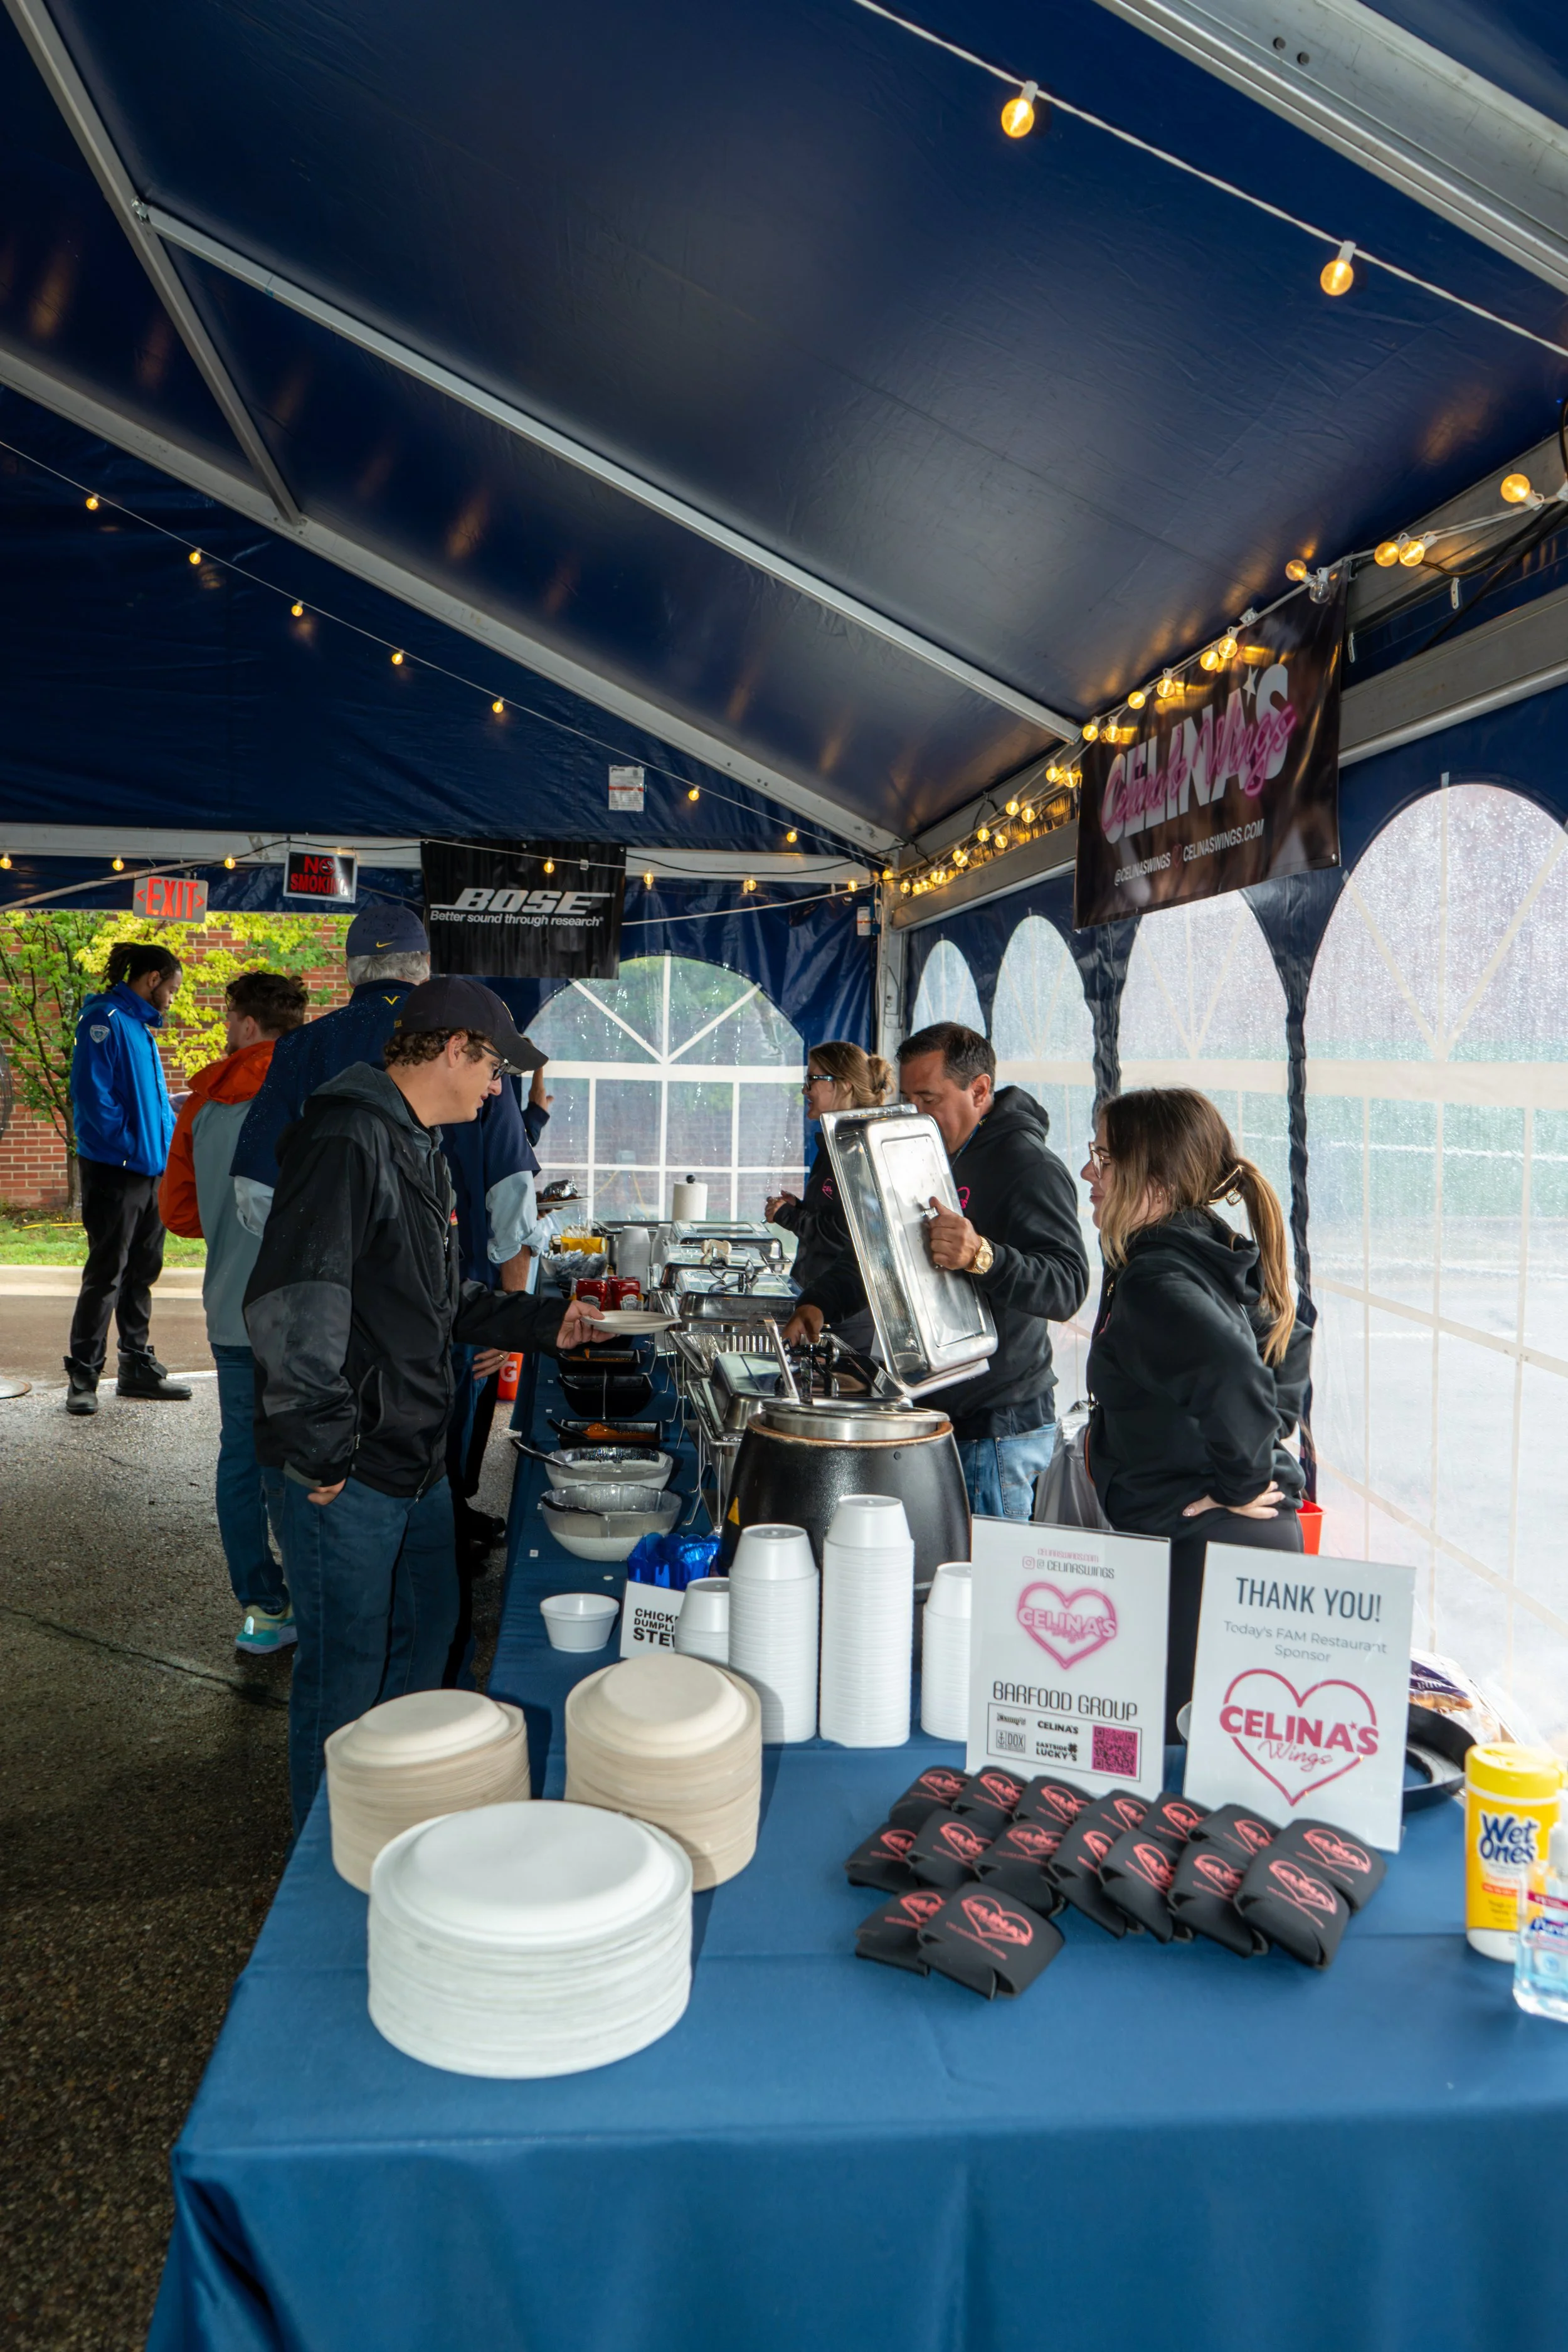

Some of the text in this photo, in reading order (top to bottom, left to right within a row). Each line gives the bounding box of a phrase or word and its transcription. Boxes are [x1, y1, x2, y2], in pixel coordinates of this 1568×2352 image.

[1115, 818, 1264, 886] @CELINASWINGS CELINASWINGS.COM
[304, 856, 336, 876] NO
[146, 878, 198, 918] EXIT
[430, 888, 610, 914] BOSE
[430, 910, 465, 922] Better
[467, 913, 502, 924] sound
[504, 914, 548, 927] through
[500, 1361, 517, 1382] G
[1236, 1577, 1382, 1622] THANK YOU!
[635, 1608, 679, 1623] CHICK
[1019, 1608, 1116, 1638] CELINA'S
[633, 1627, 675, 1648] STE
[1224, 1621, 1387, 1653] Today's FAM Restaurant
[1274, 1645, 1331, 1663] Sponsor
[993, 1681, 1138, 1720] BARFOOD GROUP
[1007, 1733, 1024, 1747] DOX
[1037, 1720, 1079, 1734] CELINA'S
[1219, 1705, 1379, 1756] CELINA'S
[1036, 1748, 1077, 1761] LUCKY'S
[1258, 1739, 1333, 1772] Wings
[1482, 1813, 1537, 1845] Wet
[1480, 1836, 1535, 1864] Ones
